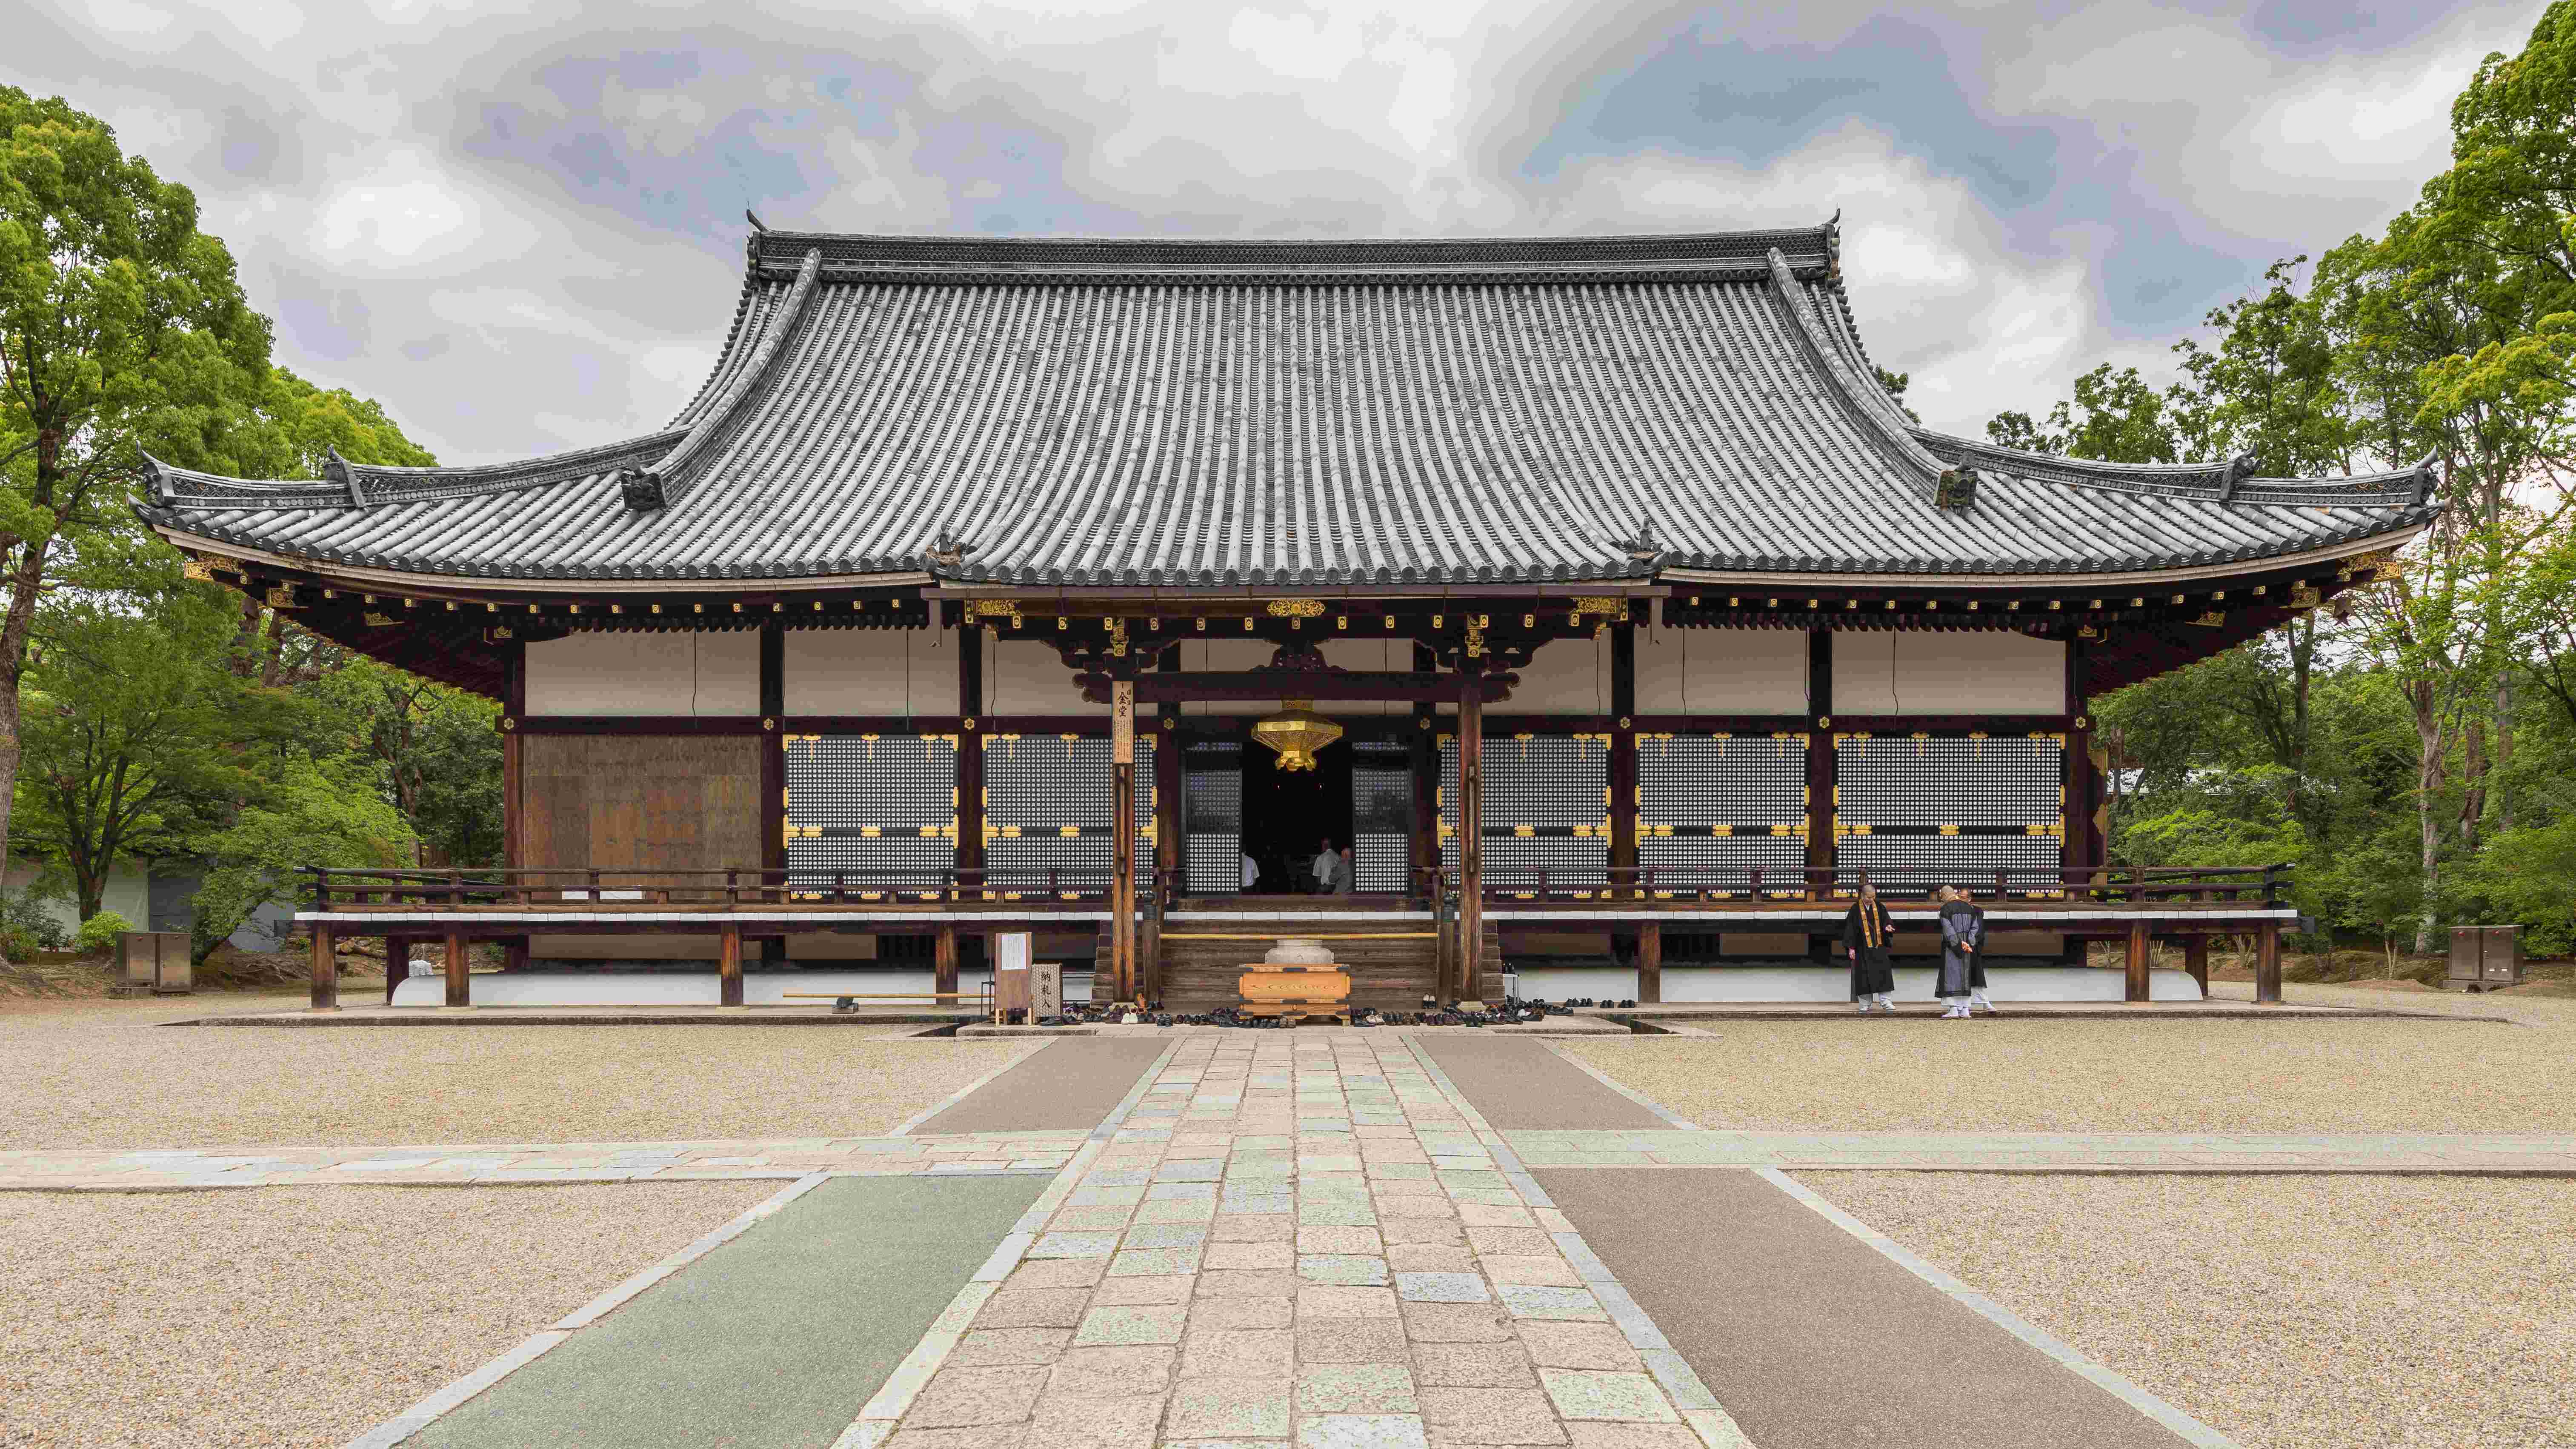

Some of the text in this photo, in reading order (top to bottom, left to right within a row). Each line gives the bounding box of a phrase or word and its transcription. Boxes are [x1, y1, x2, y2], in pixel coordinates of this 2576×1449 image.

[1117, 691, 1129, 717] 金堂
[1041, 971, 1051, 1008] 納札入
